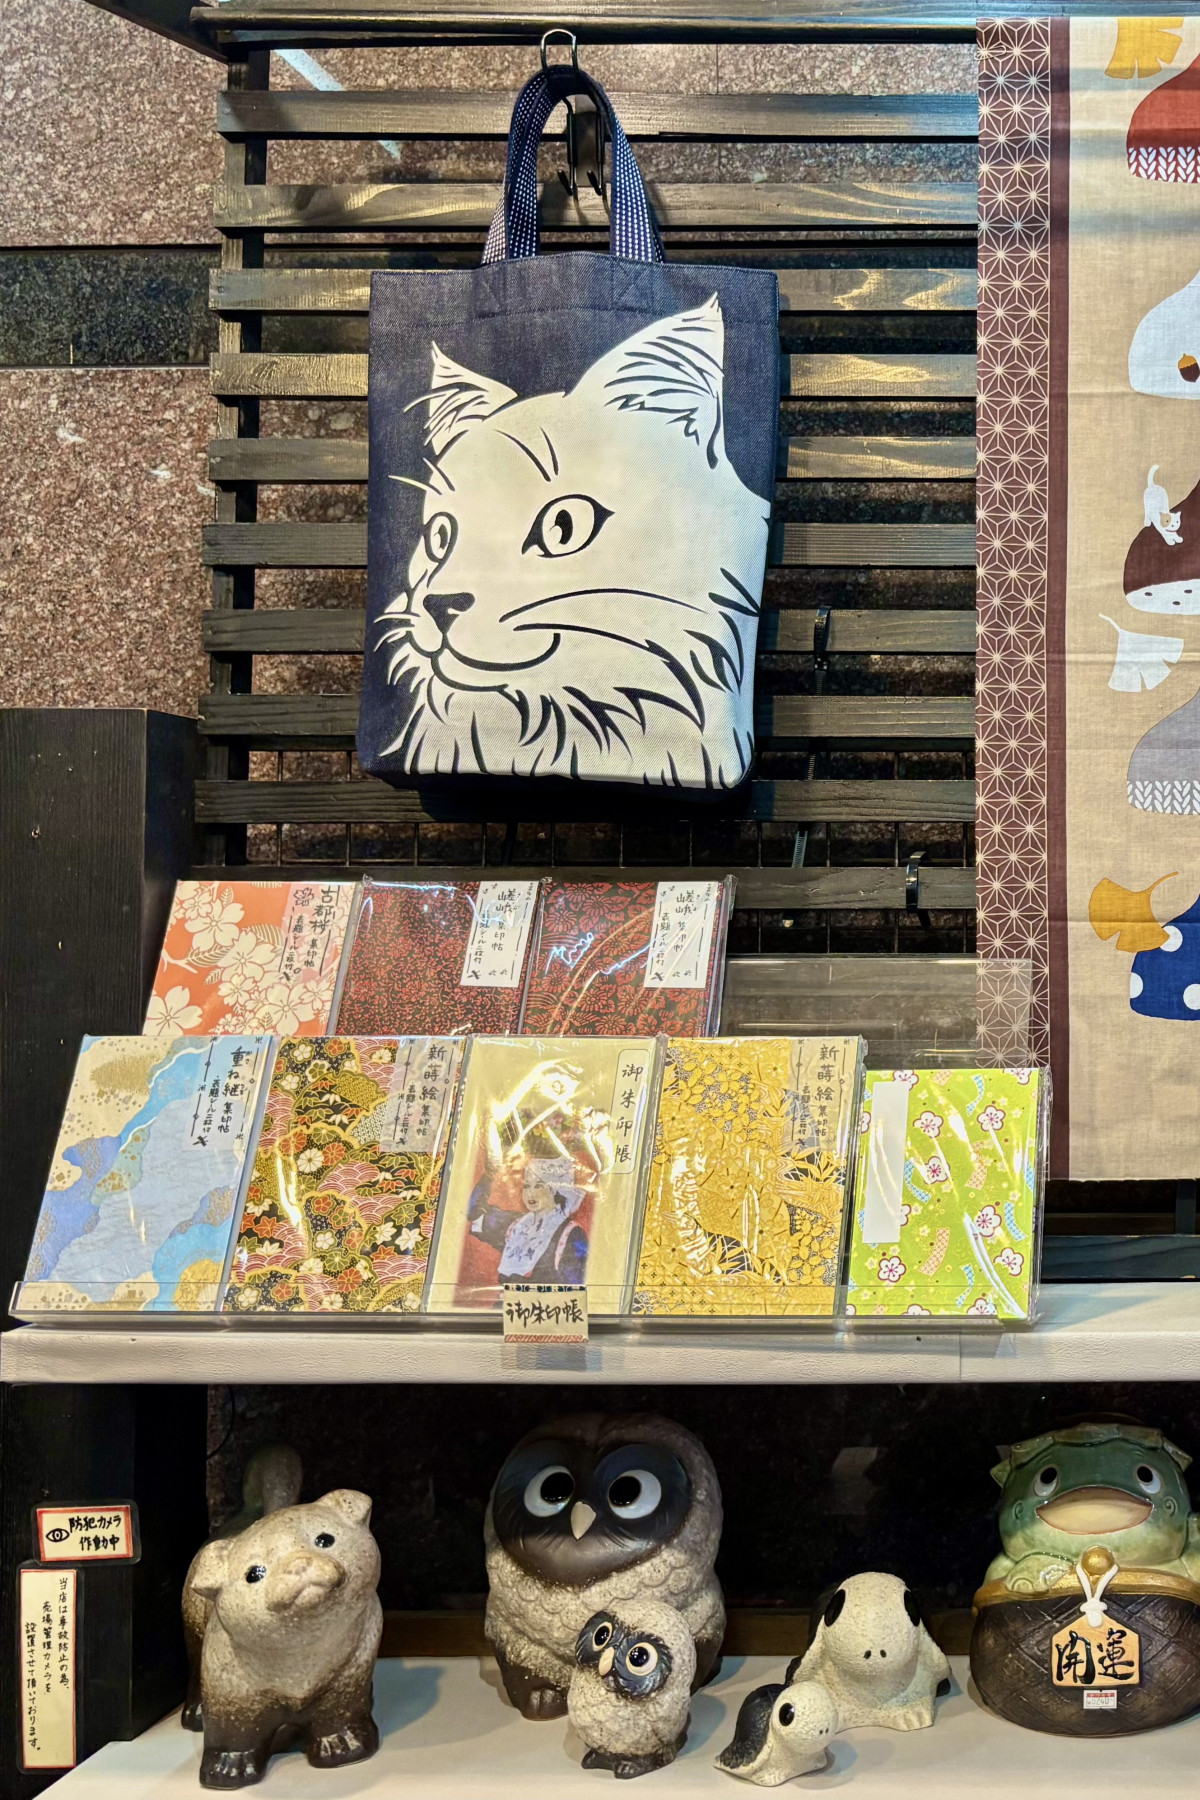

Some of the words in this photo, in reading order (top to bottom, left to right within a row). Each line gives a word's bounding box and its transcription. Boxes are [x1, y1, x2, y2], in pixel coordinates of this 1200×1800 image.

[615, 1064, 643, 1163] 御朱印帳
[505, 1298, 584, 1329] 御朱印帳
[68, 1514, 122, 1532] 防犯カメラ
[79, 1535, 121, 1551] 作動中
[1055, 1627, 1135, 1685] 開運
